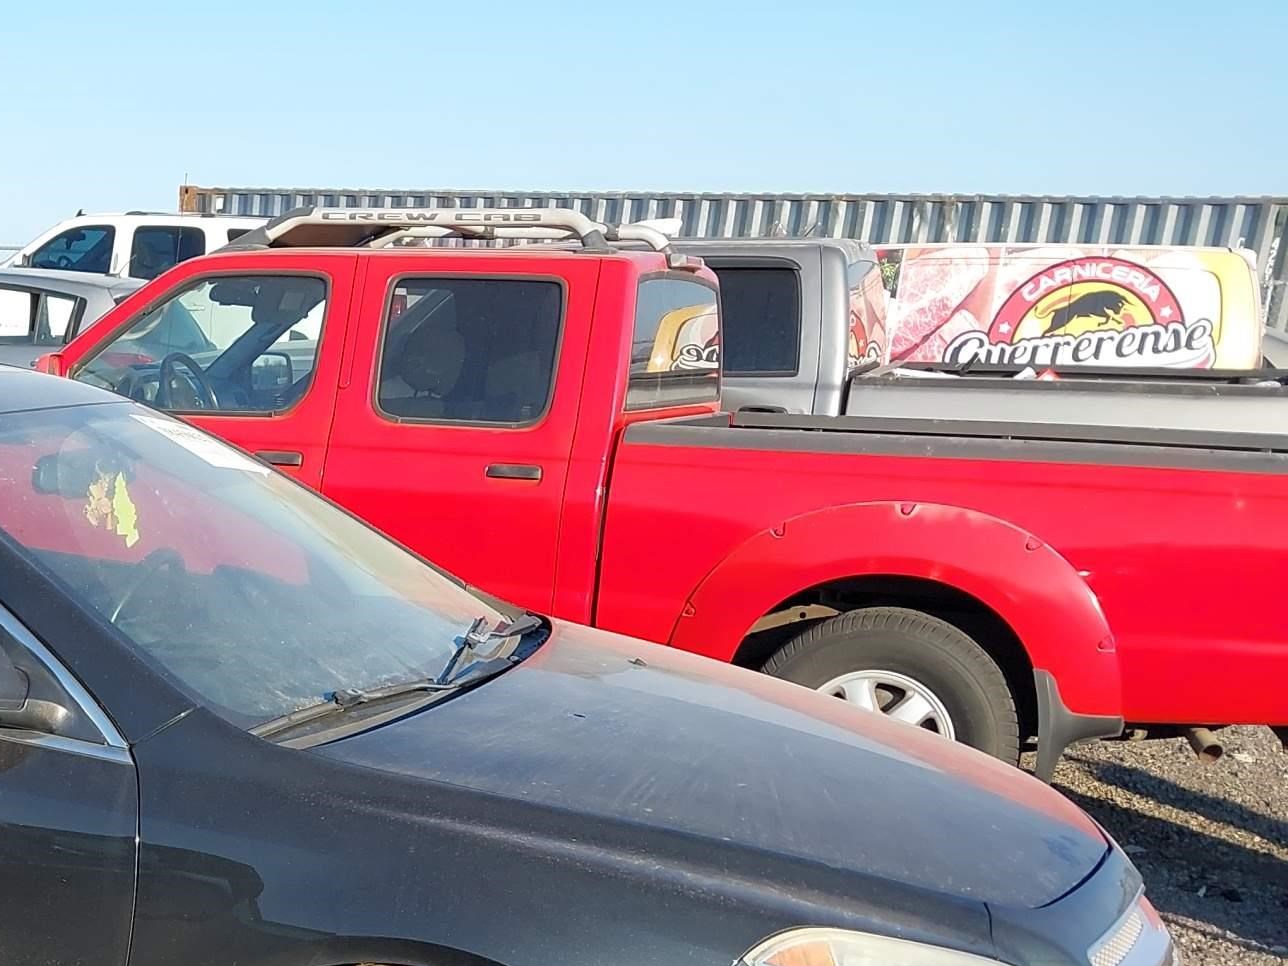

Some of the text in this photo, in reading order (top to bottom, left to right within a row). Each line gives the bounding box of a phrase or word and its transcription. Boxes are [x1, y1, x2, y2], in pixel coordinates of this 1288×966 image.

[321, 211, 543, 223] CREW CAB
[1021, 261, 1161, 302] CARNICERIA
